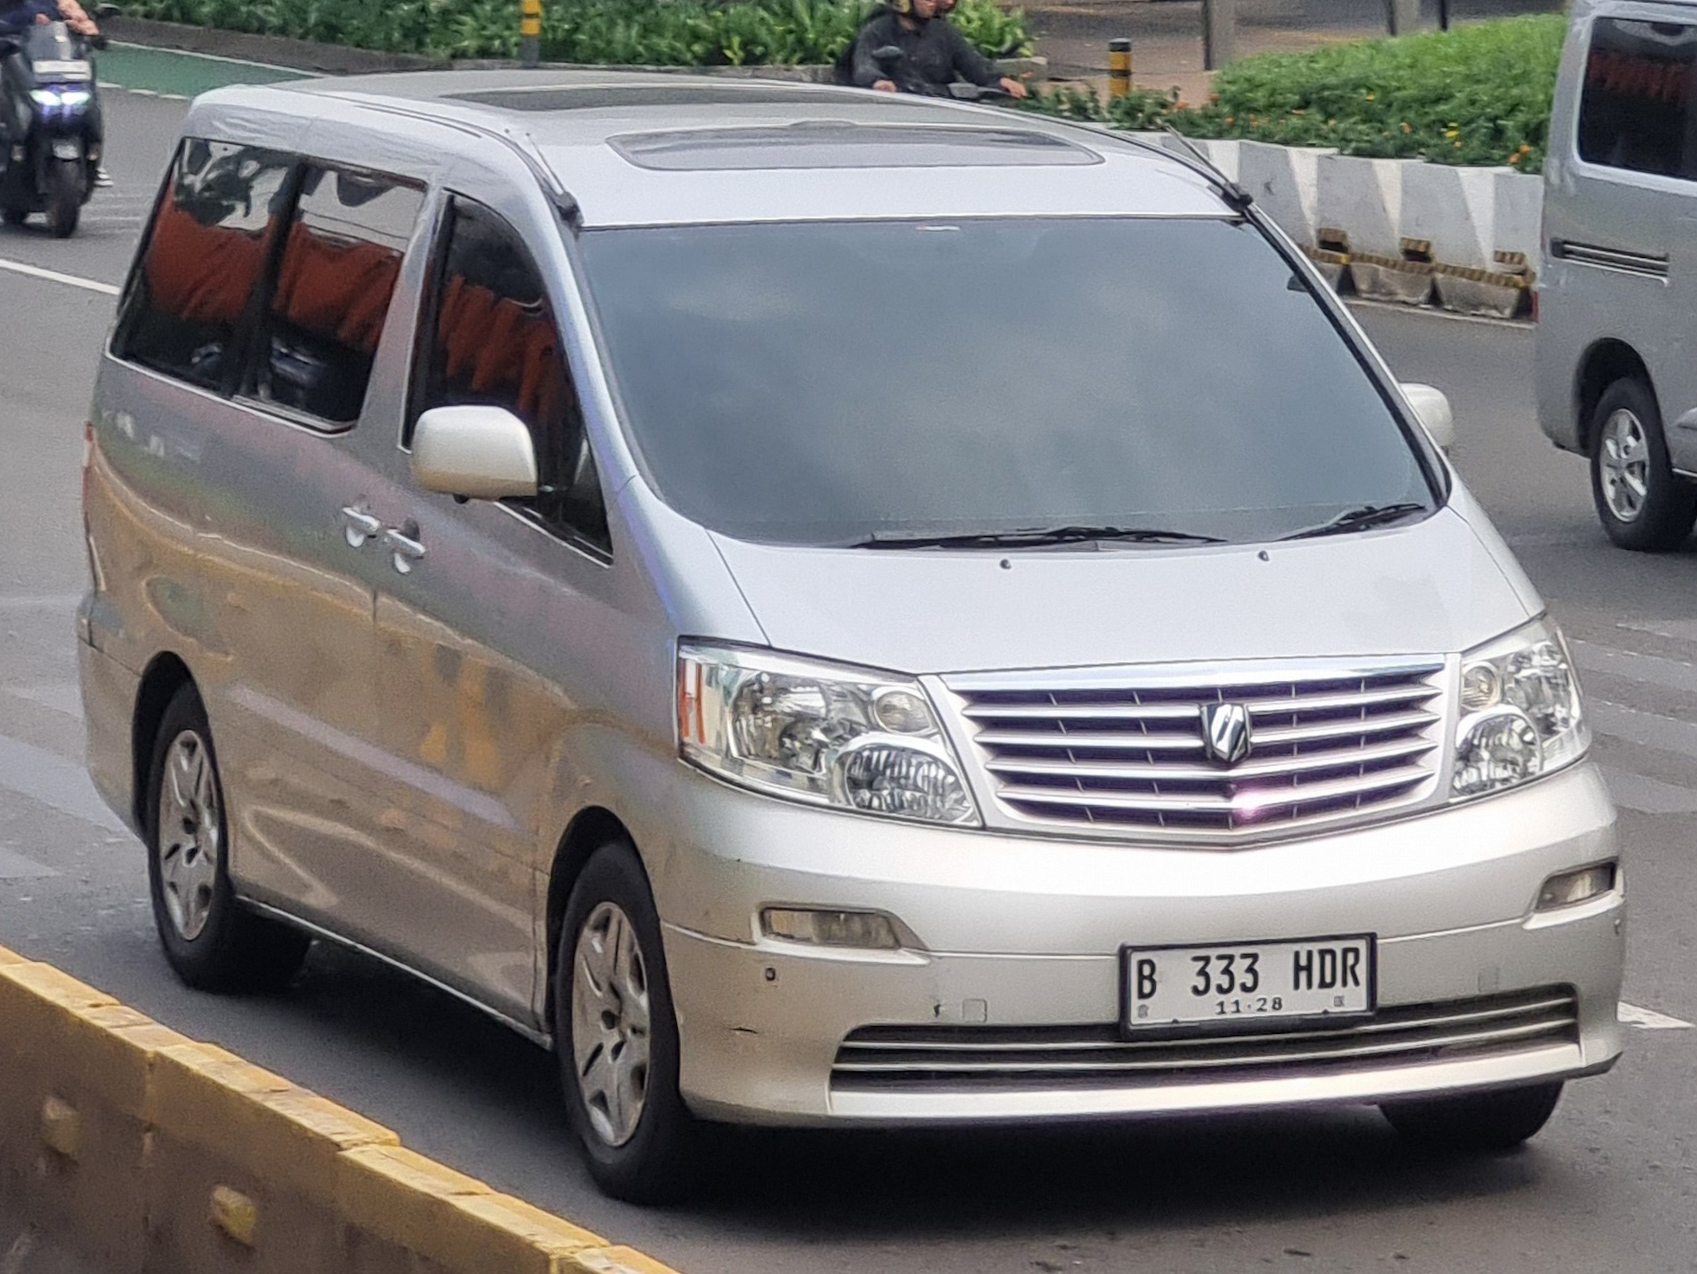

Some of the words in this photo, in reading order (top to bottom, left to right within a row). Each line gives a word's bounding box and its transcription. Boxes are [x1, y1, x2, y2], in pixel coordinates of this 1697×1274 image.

[1136, 958, 1157, 1001] B
[1190, 952, 1260, 997] 333
[1292, 946, 1361, 991] HDR
